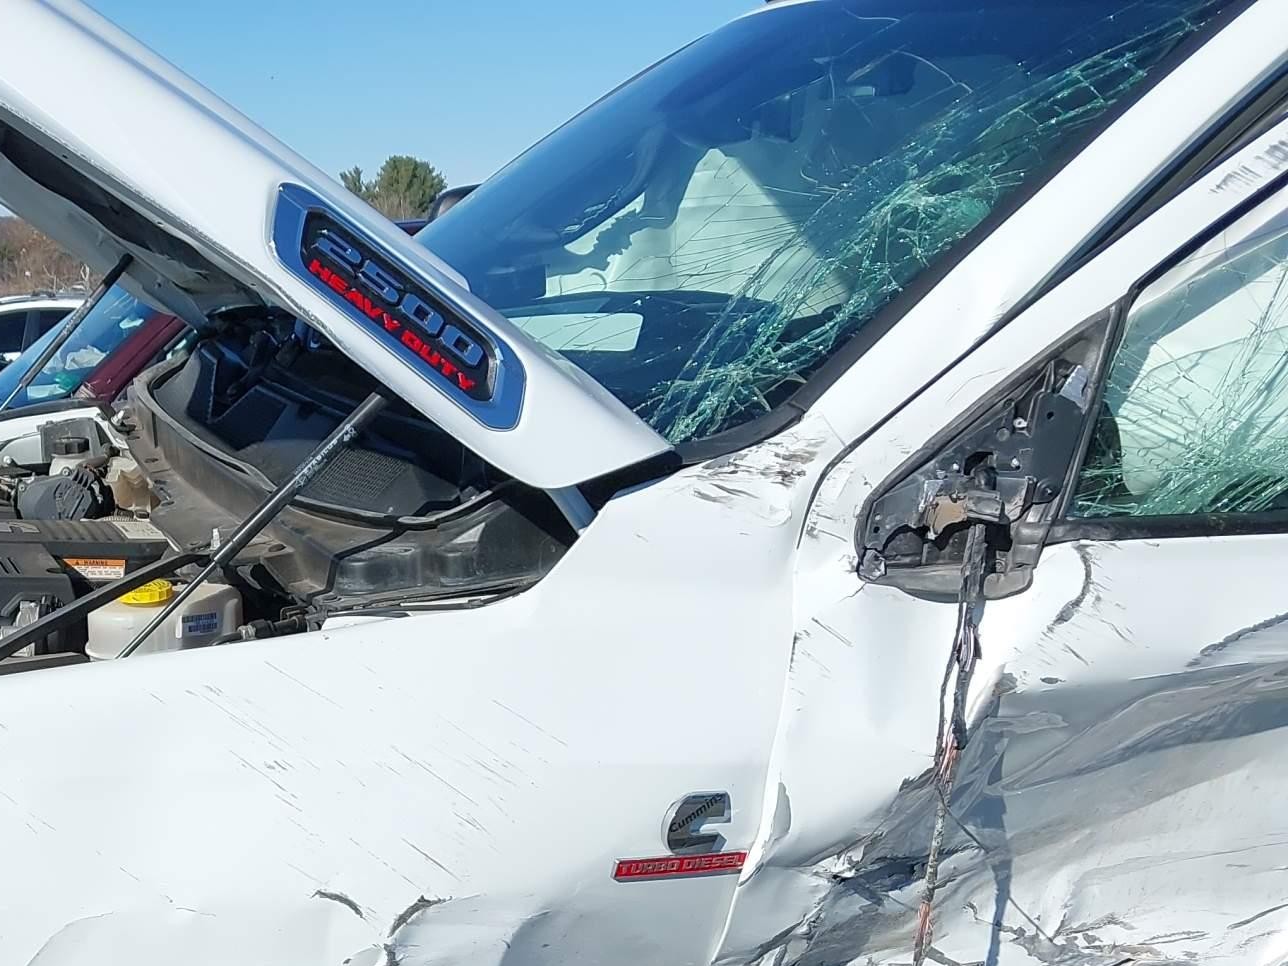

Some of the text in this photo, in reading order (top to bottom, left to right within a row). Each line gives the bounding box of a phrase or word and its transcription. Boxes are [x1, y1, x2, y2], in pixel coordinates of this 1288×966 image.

[307, 258, 476, 391] HEAVY DUTY
[310, 229, 484, 367] 2500
[668, 792, 725, 833] Cummins
[619, 854, 744, 875] TURBO DIESEL
